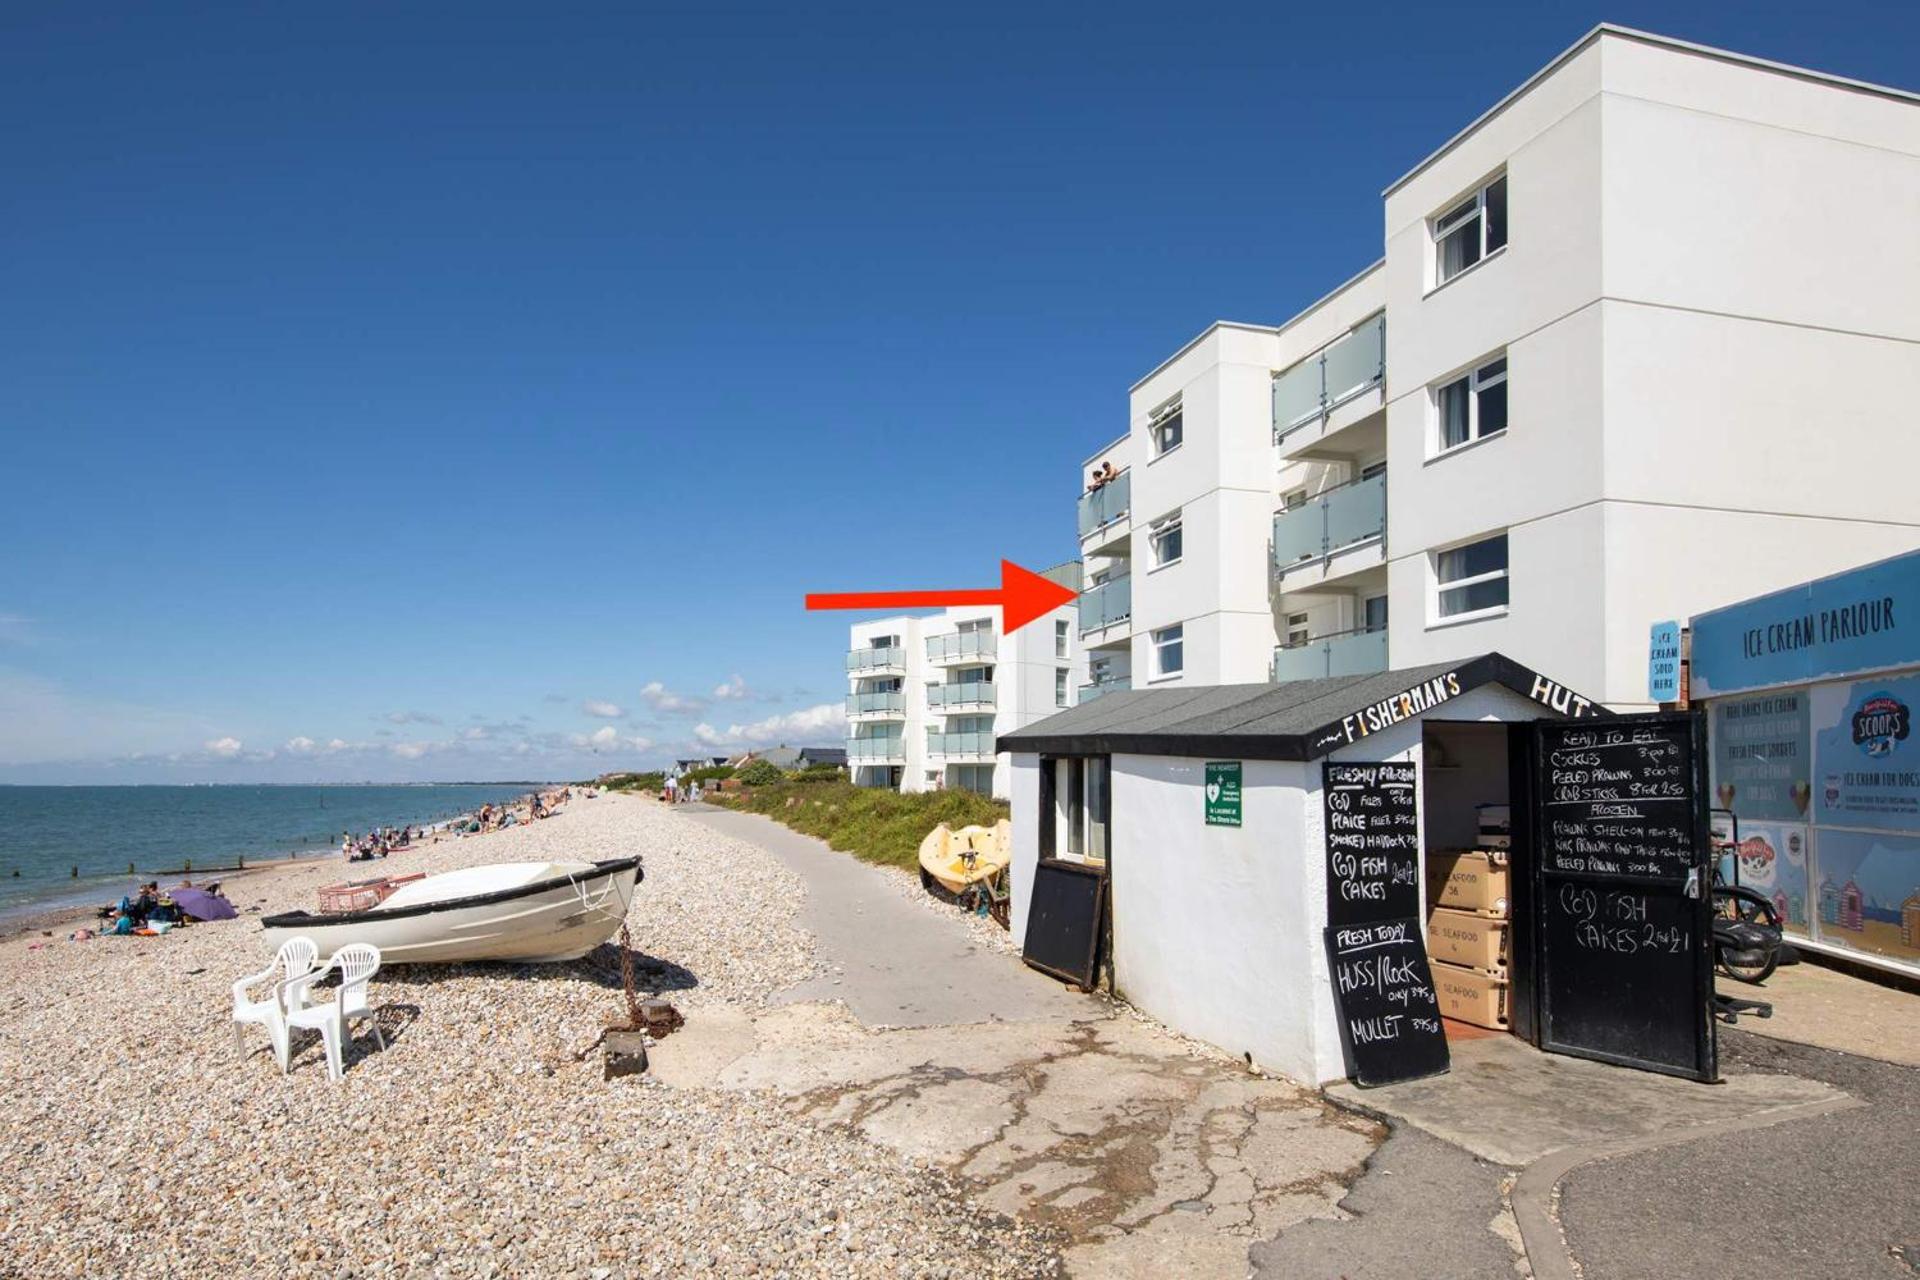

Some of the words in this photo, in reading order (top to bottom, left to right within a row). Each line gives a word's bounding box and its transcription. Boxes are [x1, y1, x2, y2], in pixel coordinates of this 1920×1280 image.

[1743, 627, 1763, 660] ICE
[1768, 618, 1815, 653] CREAM
[1821, 597, 1895, 643] PARLOUR
[1658, 632, 1671, 644] ICE
[1651, 647, 1678, 660] CREAM
[1654, 663, 1674, 675] SOLD
[1654, 678, 1673, 689] HERE
[1529, 674, 1591, 718] HUT
[1342, 672, 1461, 744] FISHERMAN'S
[1604, 730, 1624, 744] TO
[1856, 772, 1880, 786] CREAM
[1328, 792, 1350, 811] COD
[1591, 803, 1638, 816] FROZEN
[1341, 880, 1386, 901] CAKES
[1337, 928, 1372, 948] FRESH
[1374, 922, 1407, 945] TODAY
[1351, 1014, 1404, 1045] MULLET
